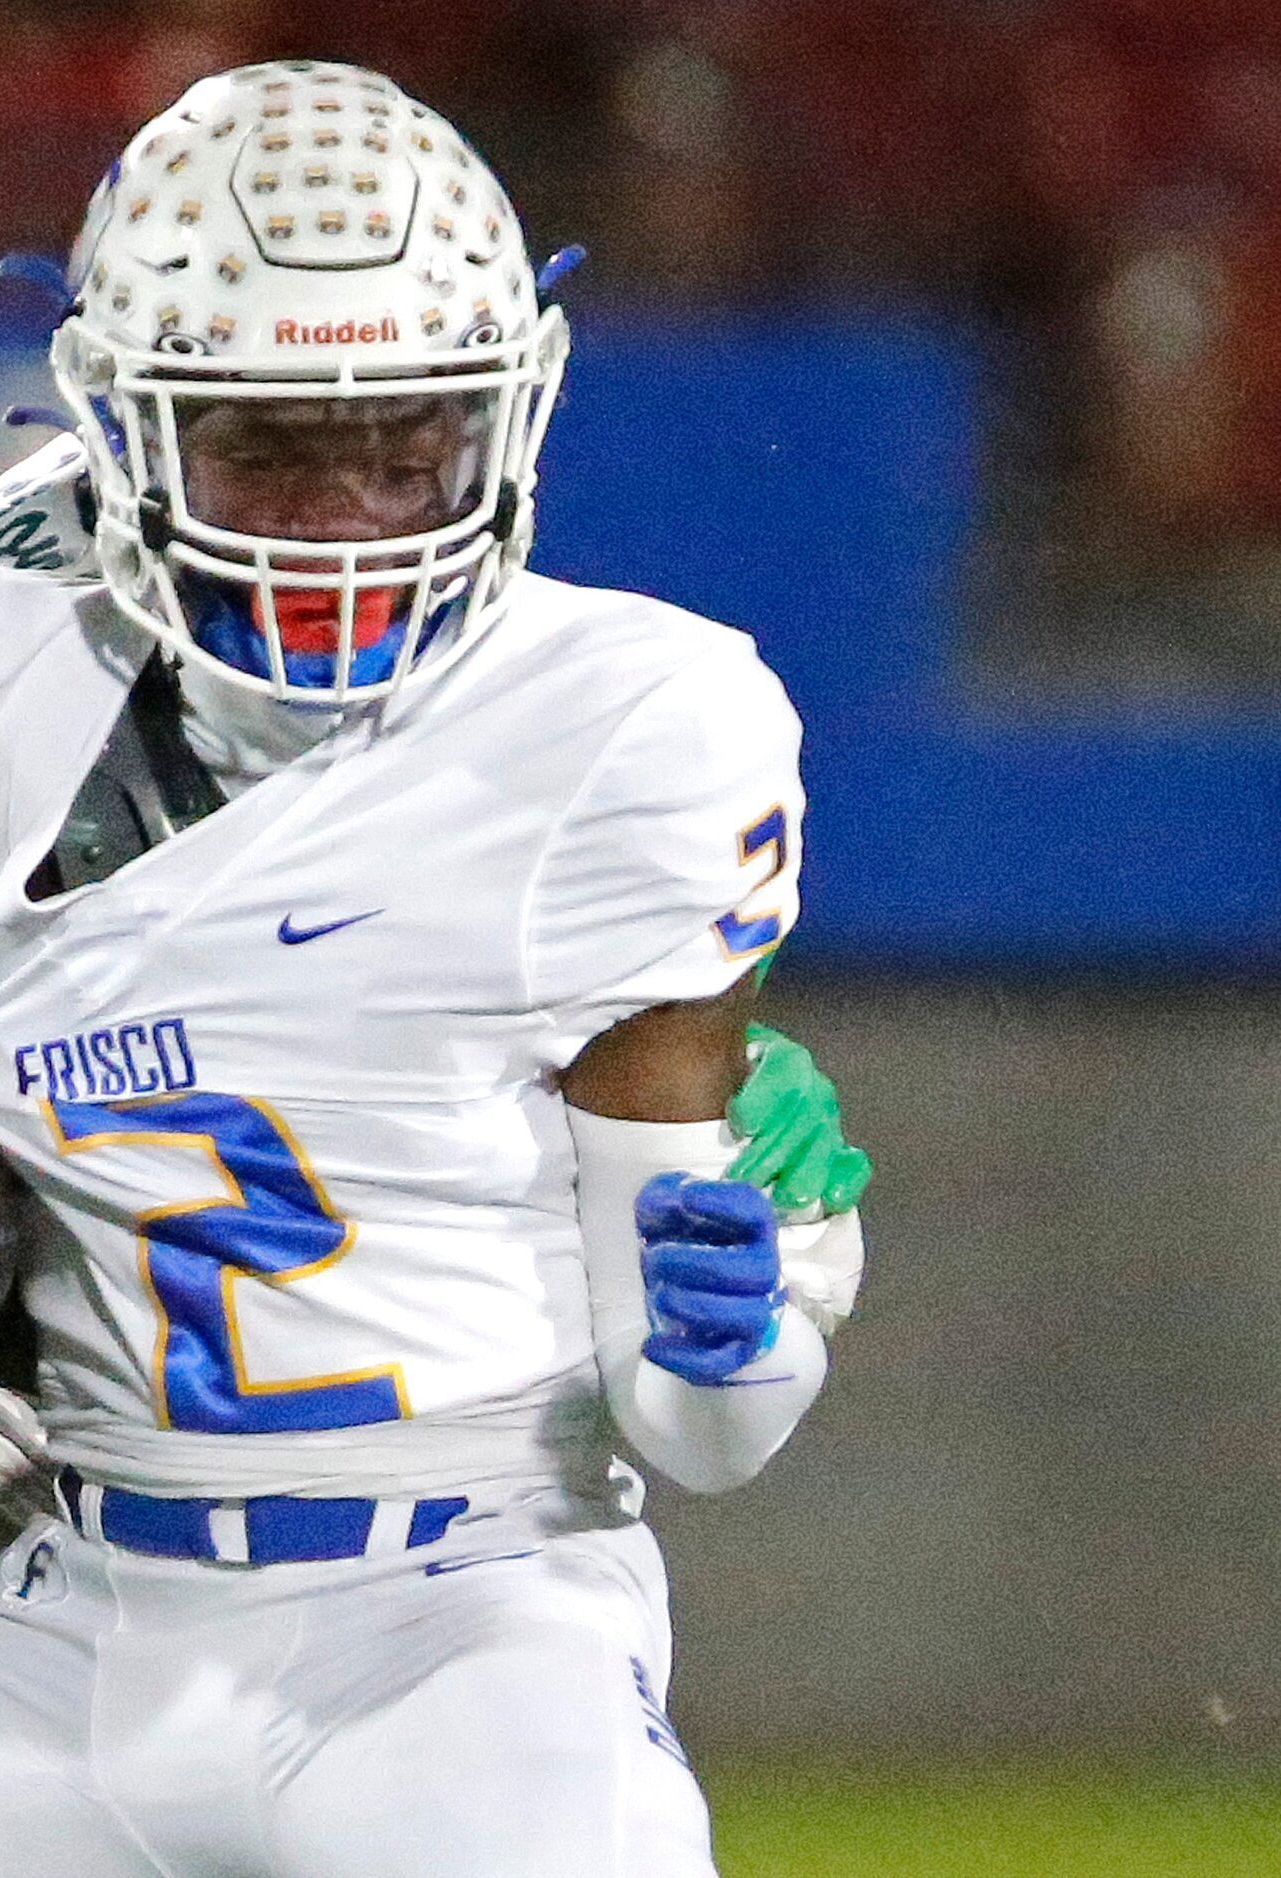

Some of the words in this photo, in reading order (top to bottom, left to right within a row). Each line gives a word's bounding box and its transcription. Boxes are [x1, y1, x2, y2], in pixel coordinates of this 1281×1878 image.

[275, 316, 398, 344] Riddell
[709, 801, 789, 964] 2
[15, 1018, 198, 1104] FRISCO
[38, 1090, 412, 1434] 2
